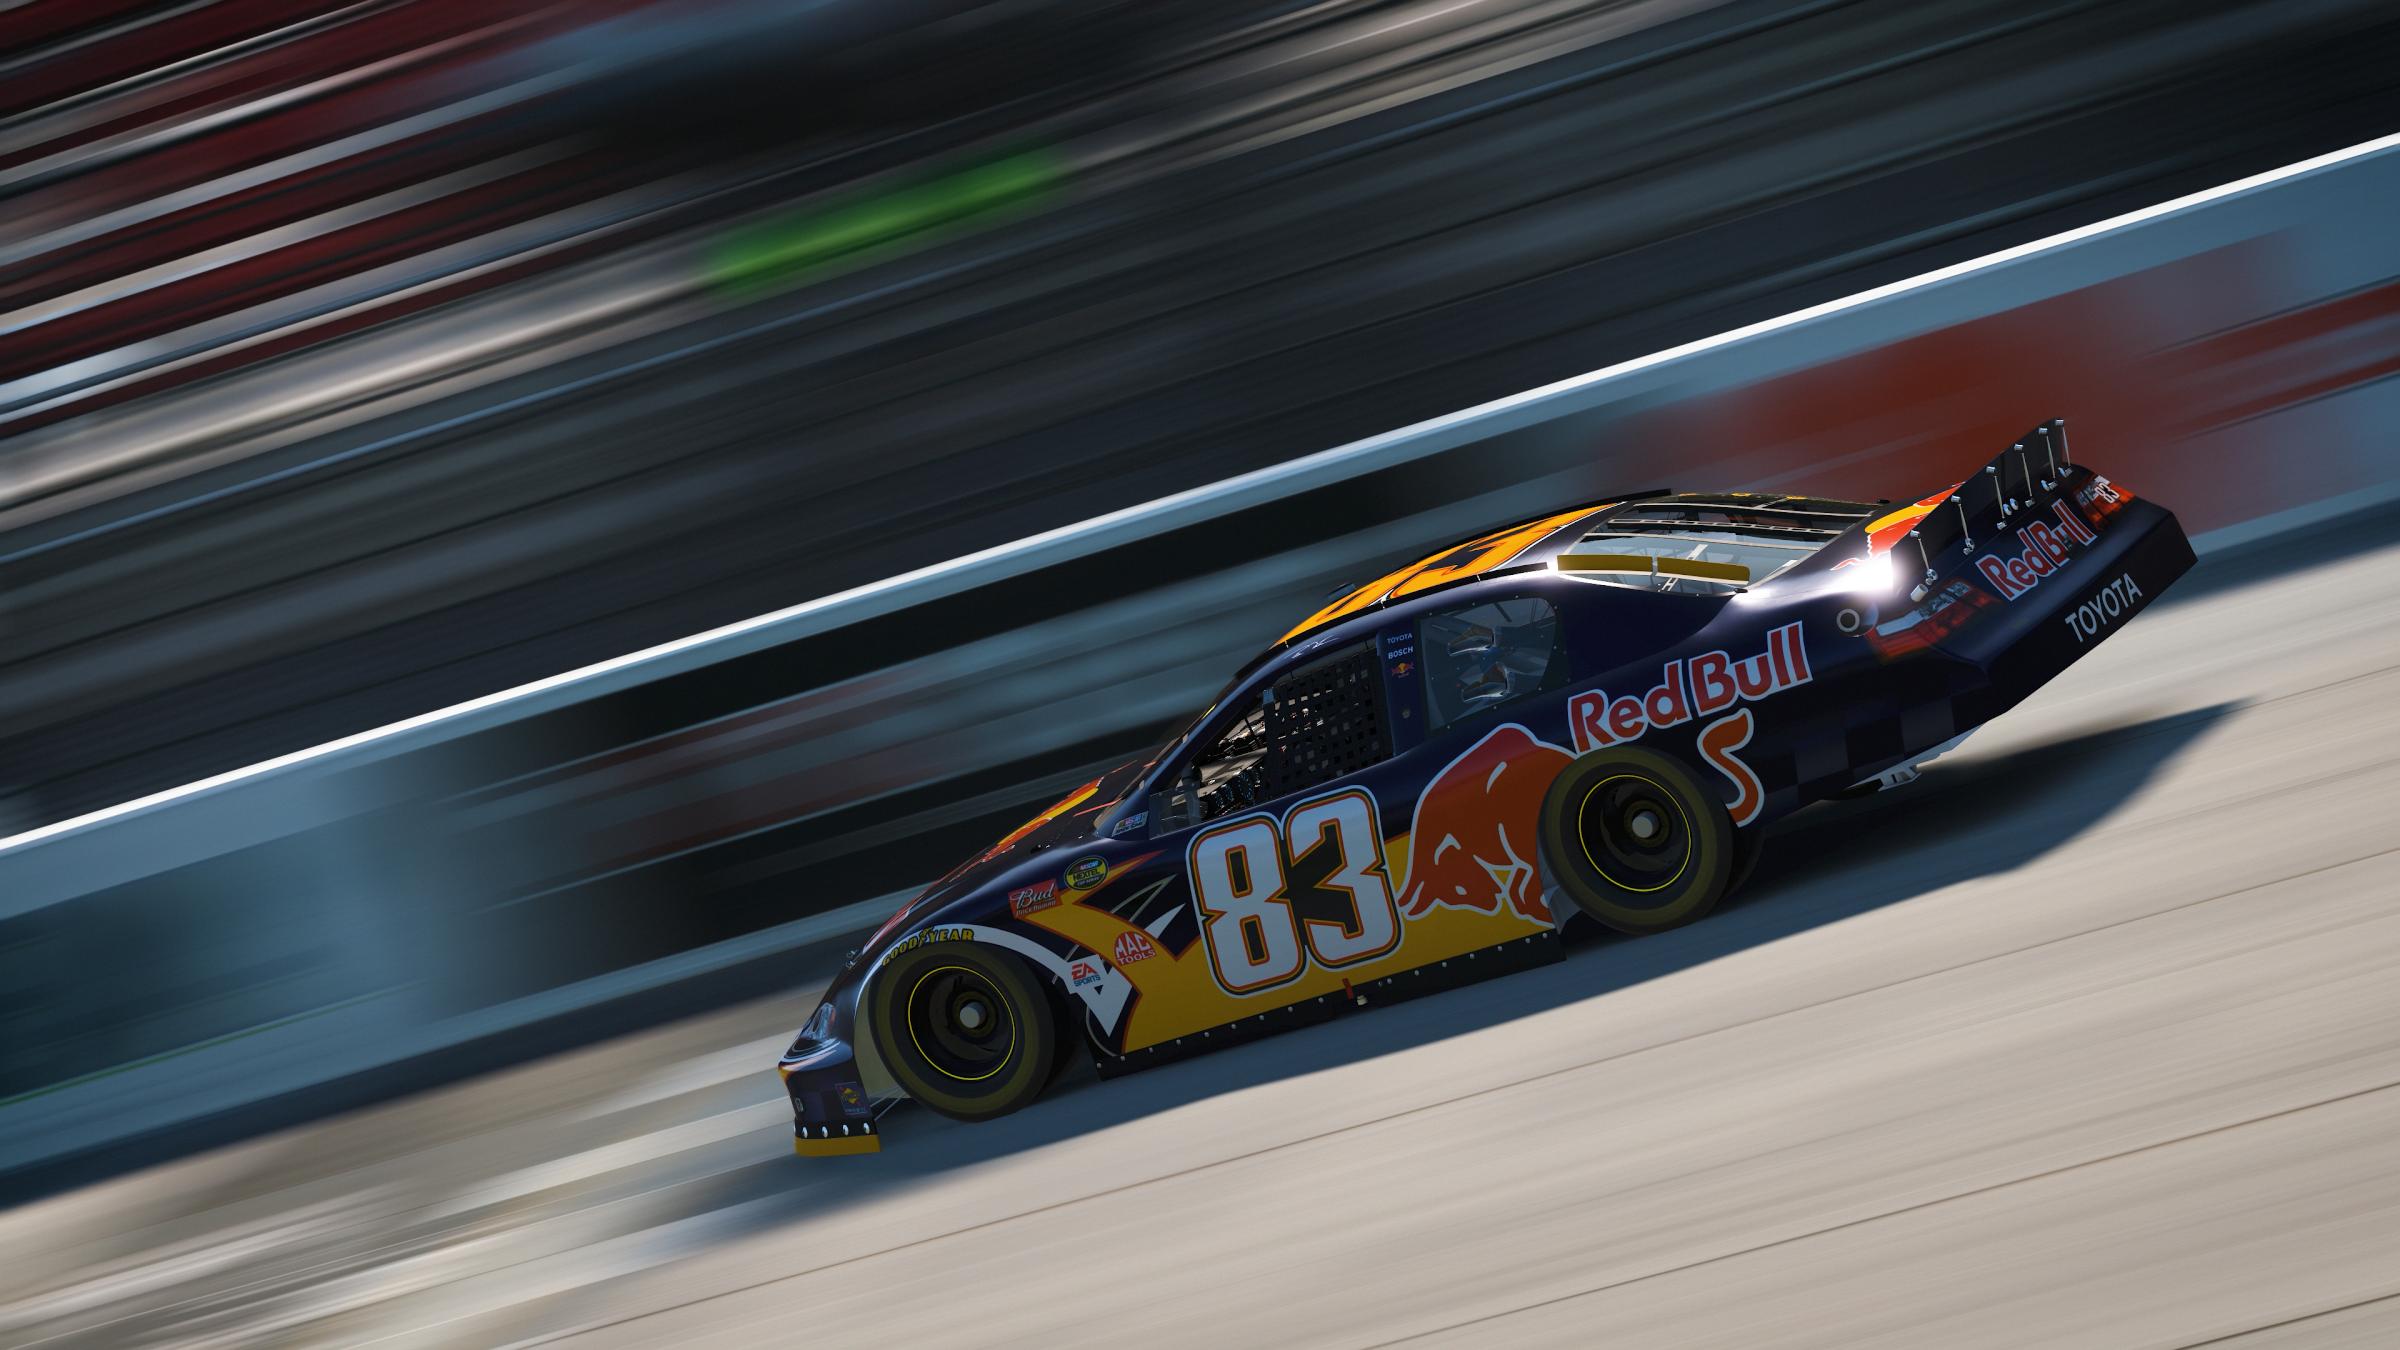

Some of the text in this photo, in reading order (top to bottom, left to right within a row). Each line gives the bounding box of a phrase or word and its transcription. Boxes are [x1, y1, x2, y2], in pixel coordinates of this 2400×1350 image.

[2094, 482, 2120, 504] 83
[1975, 528, 2058, 601] Red
[2065, 573, 2143, 643] TOYOTA
[1387, 632, 1413, 644] TOYOTA
[1387, 646, 1414, 660] BOSCH
[1568, 620, 1814, 756] Red Bull
[1010, 881, 1056, 909] Bud
[1187, 786, 1404, 997] 83
[1115, 932, 1150, 959] MAC
[1118, 949, 1156, 965] TOOLS
[1071, 961, 1098, 980] EA
[1073, 974, 1101, 988] SPORTS
